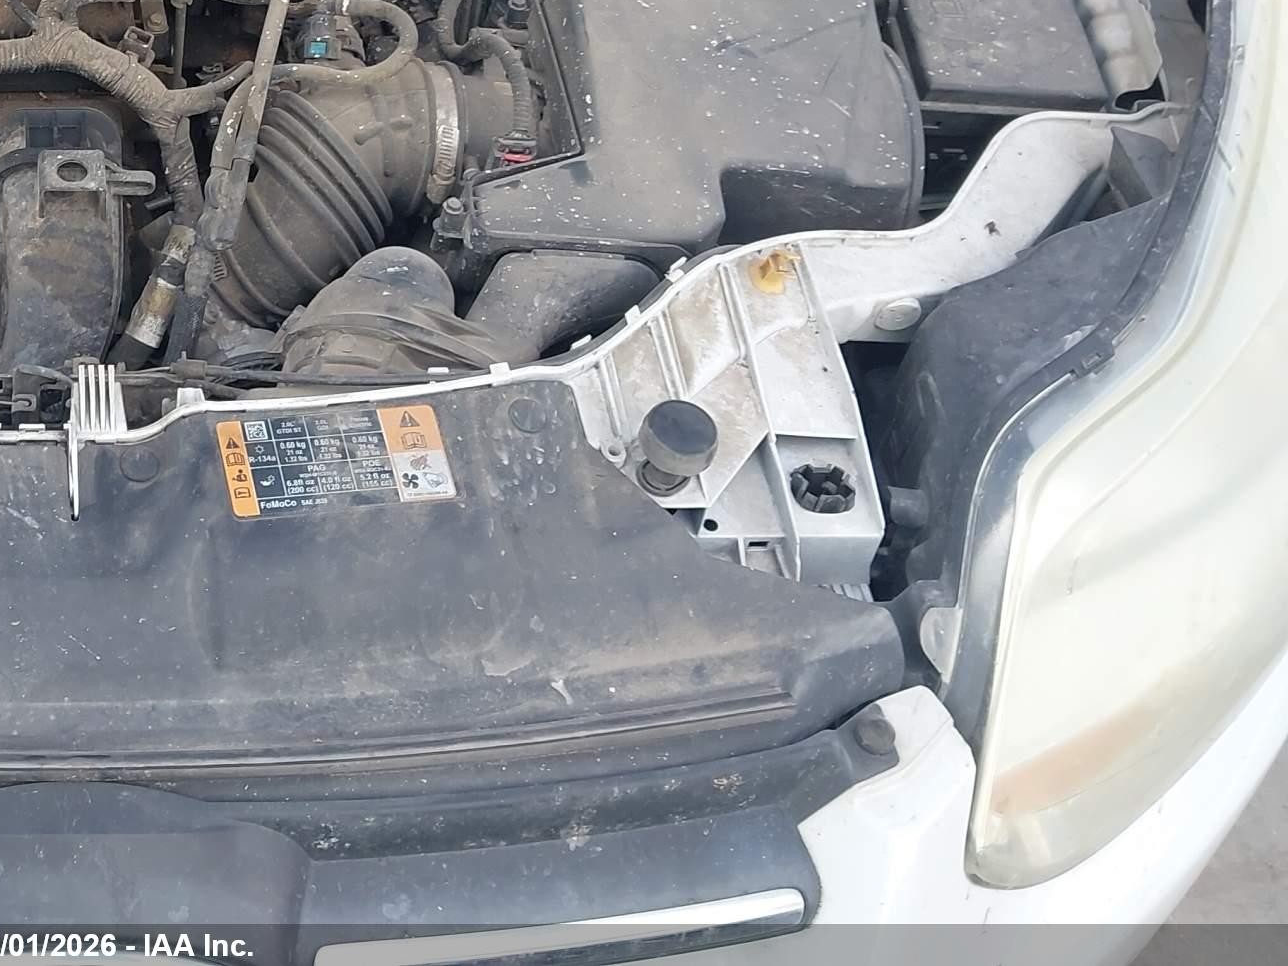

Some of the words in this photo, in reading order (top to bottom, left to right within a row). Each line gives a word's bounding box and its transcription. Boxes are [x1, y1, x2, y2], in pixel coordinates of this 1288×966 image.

[330, 438, 340, 446] kg
[368, 435, 379, 443] kg
[295, 441, 306, 449] kg
[248, 455, 276, 463] R-134a
[307, 464, 326, 472] PAG
[287, 486, 304, 495] (200
[305, 485, 319, 494] cc)
[323, 483, 340, 491] (120
[341, 482, 354, 491] cc)
[260, 499, 297, 509] FoMoCo
